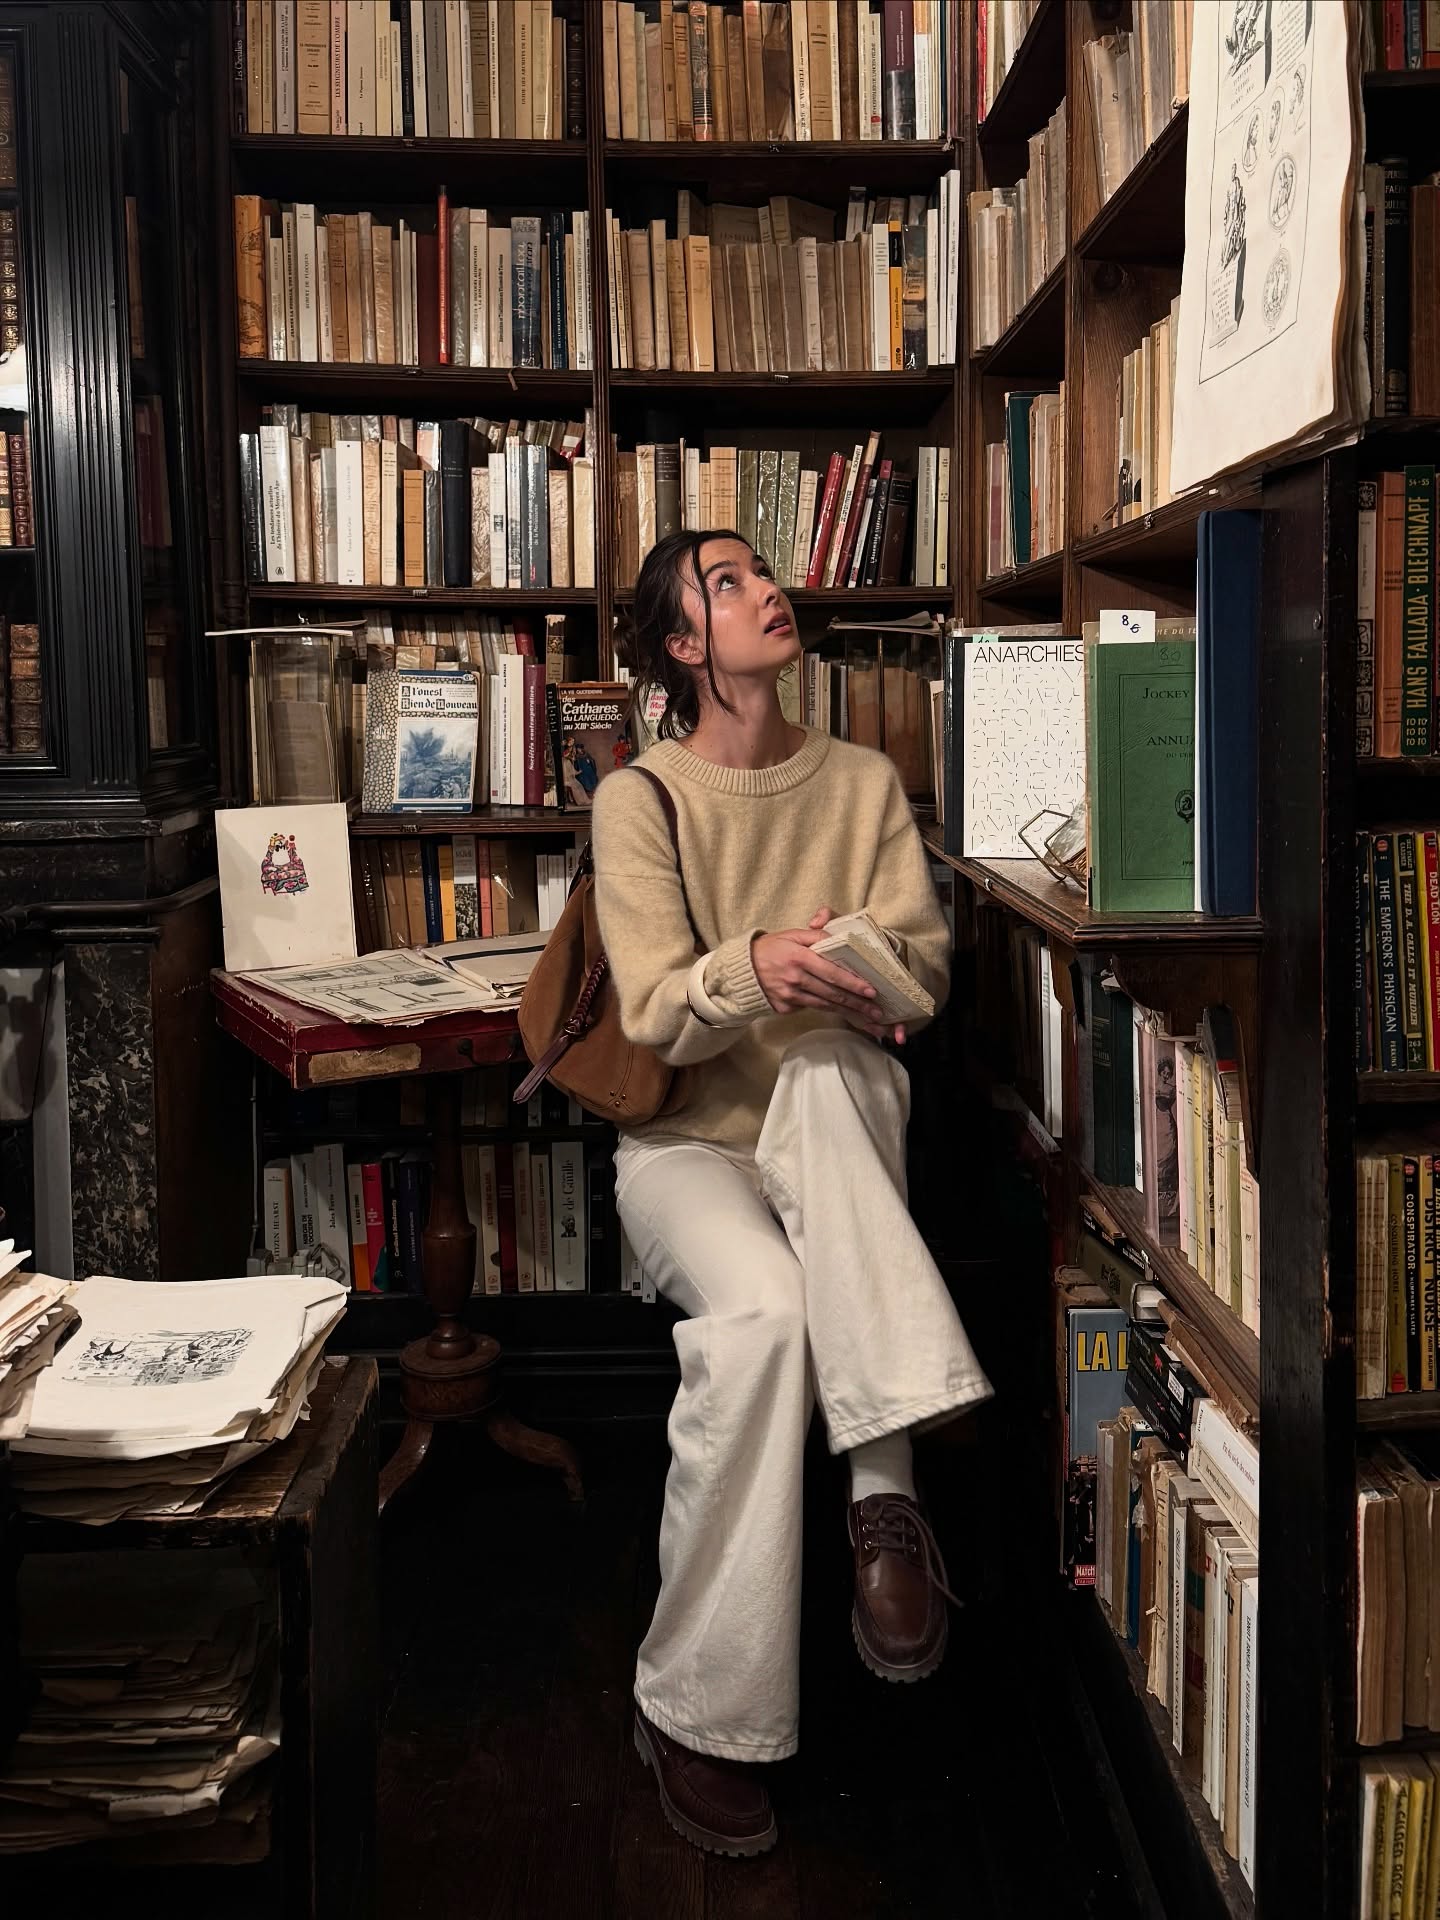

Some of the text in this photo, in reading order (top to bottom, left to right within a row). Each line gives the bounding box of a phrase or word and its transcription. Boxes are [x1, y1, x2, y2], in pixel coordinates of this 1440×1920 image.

[1406, 496, 1429, 708] HANS FALLADA BLECHNAPF
[974, 645, 1084, 663] ANARCHIES
[412, 687, 442, 696] l'ouest
[1142, 688, 1190, 700] JOCKEY
[402, 698, 477, 710] Rien de Nouveau
[562, 702, 618, 714] Cathares
[573, 714, 622, 722] LANGUEDOC
[590, 722, 612, 730] Siècle
[1379, 878, 1390, 901] THE
[1429, 872, 1438, 898] DEAD
[1405, 908, 1412, 918] D.
[1431, 902, 1440, 925] LION
[1380, 907, 1394, 967] EMPEROR'S
[1406, 921, 1413, 930] A.
[1407, 933, 1415, 964] CALLS
[1408, 968, 1416, 980] IT
[1384, 974, 1397, 1032] PHYSICIAN
[1408, 983, 1418, 1025] MURDER
[561, 1160, 574, 1210] de Gaulle
[1406, 1193, 1416, 1269] CONSPIRATOR
[1424, 1198, 1434, 1265] DISTRICT
[1425, 1278, 1434, 1332] NURSE
[1076, 1331, 1112, 1372] LA
